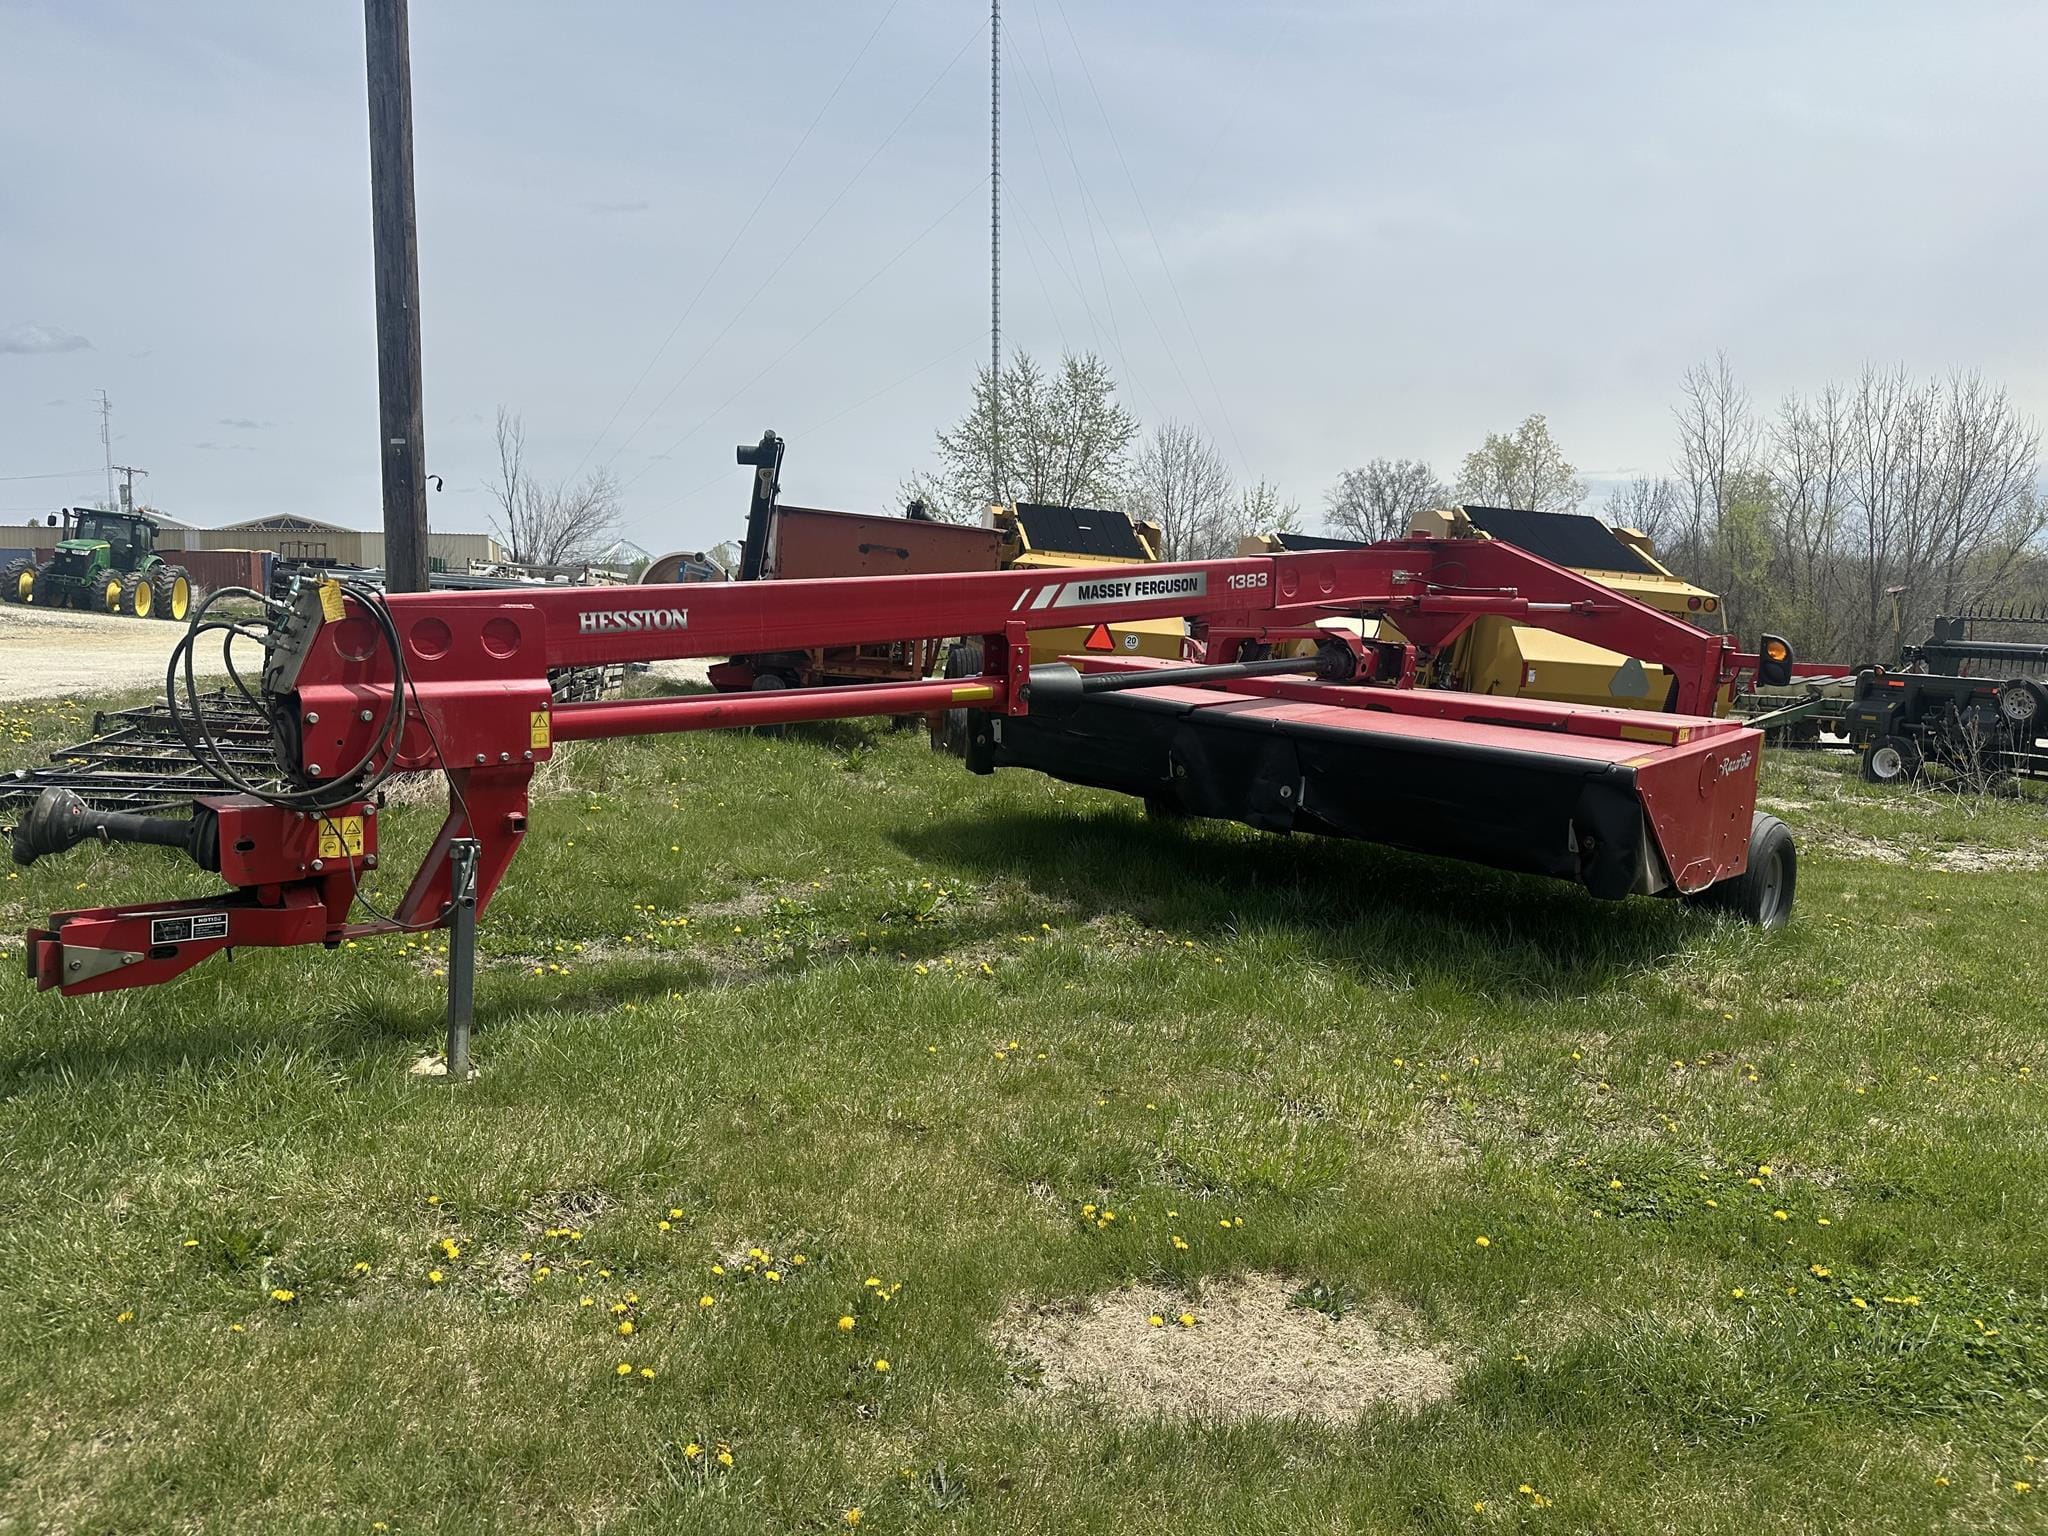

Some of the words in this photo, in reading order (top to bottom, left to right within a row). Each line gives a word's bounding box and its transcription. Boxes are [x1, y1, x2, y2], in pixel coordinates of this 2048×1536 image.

[1078, 582, 1132, 600] MASSEY
[1134, 577, 1199, 596] FERGUSON
[1227, 572, 1268, 589] 1383
[579, 608, 688, 633] HESSTON
[1126, 636, 1137, 645] 20
